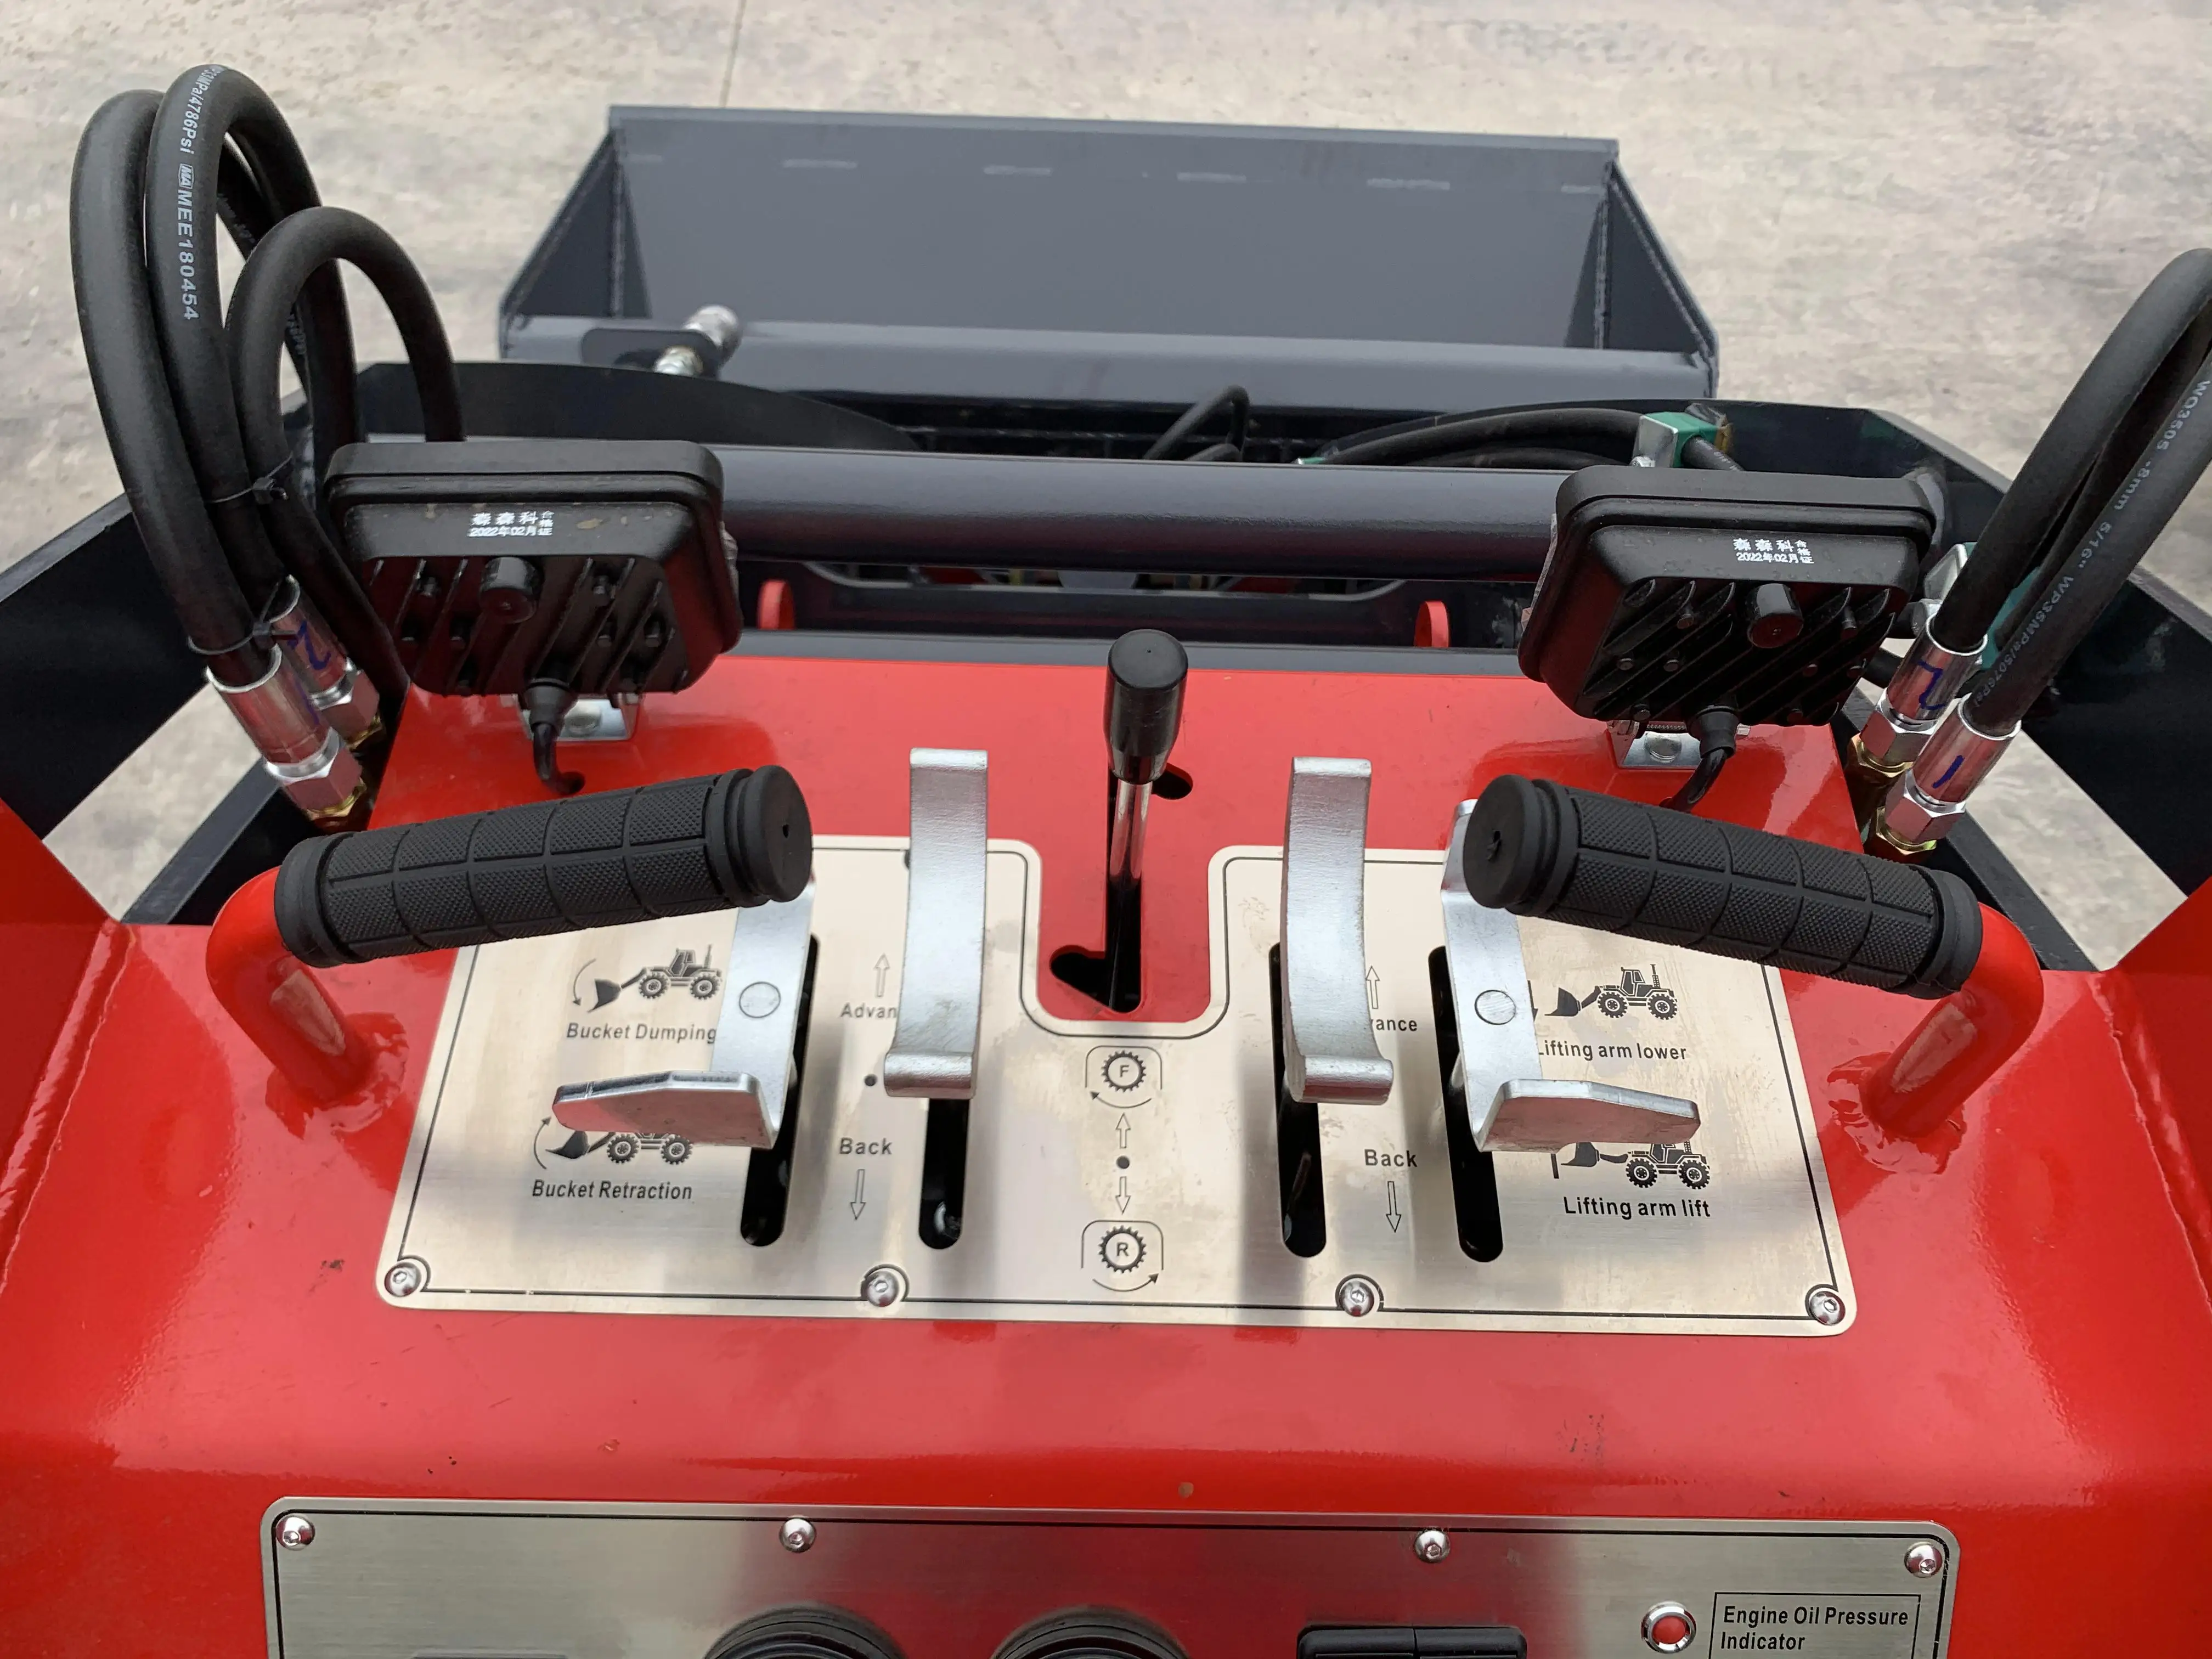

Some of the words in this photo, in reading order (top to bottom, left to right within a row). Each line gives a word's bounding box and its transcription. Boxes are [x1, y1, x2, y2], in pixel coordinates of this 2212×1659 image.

[178, 189, 199, 320] MEE180454
[566, 1022, 630, 1040] Bucket
[635, 1023, 717, 1045] Dumping
[1598, 1045, 1632, 1058] arm
[1636, 1043, 1686, 1059] lower
[1119, 1064, 1130, 1078] F
[839, 1137, 893, 1155] Back
[1364, 1149, 1418, 1168] Back
[532, 1179, 594, 1199] Bucket
[599, 1181, 692, 1200] Retraction
[1564, 1197, 1631, 1220] Lifting
[1637, 1203, 1677, 1217] arm
[1681, 1199, 1711, 1217] lift
[1117, 1243, 1128, 1257] R
[1724, 1606, 1788, 1628] Engine
[1794, 1606, 1819, 1624] Oil
[1825, 1607, 1909, 1626] Pressure
[1721, 1632, 1805, 1650] Indicator
